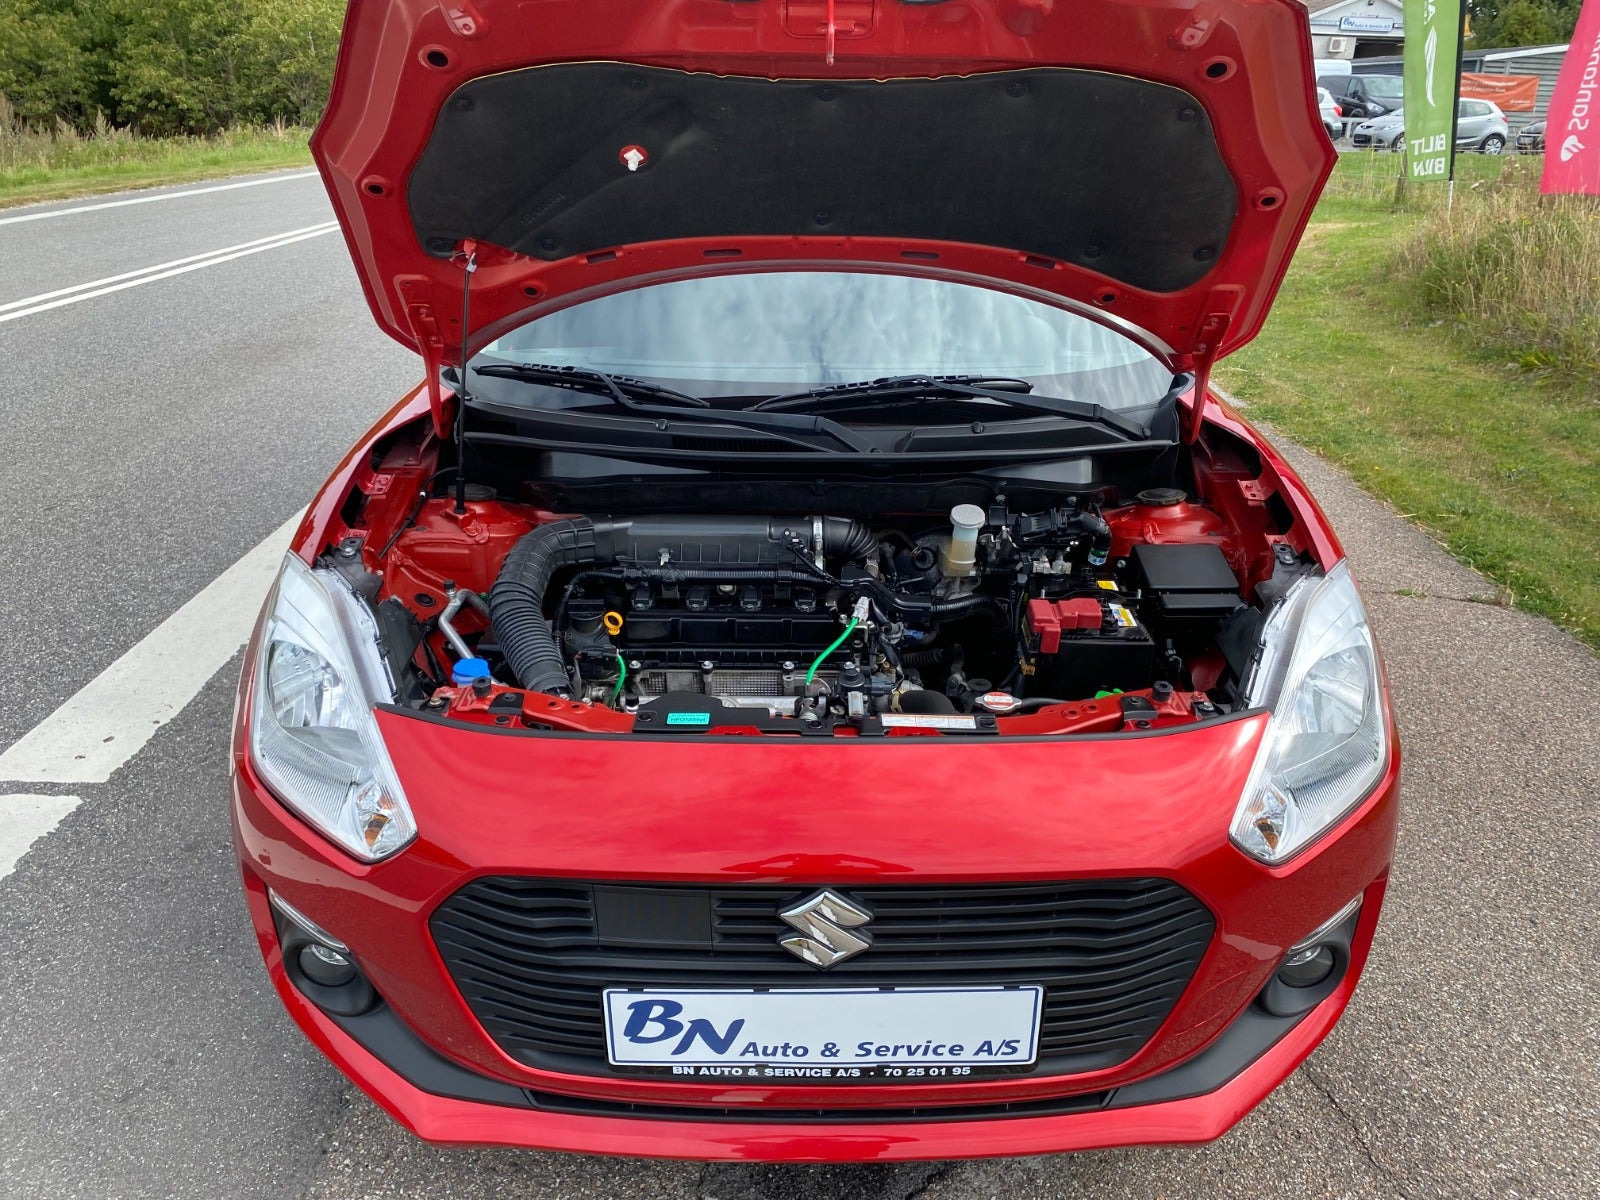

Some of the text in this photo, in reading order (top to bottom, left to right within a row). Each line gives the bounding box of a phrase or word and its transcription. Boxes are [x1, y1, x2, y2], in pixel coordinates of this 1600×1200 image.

[623, 999, 1020, 1057] BN Auto & Service A/S
[672, 1066, 971, 1077] BN AUTO & SERVICE A/S 70 25 01 95
